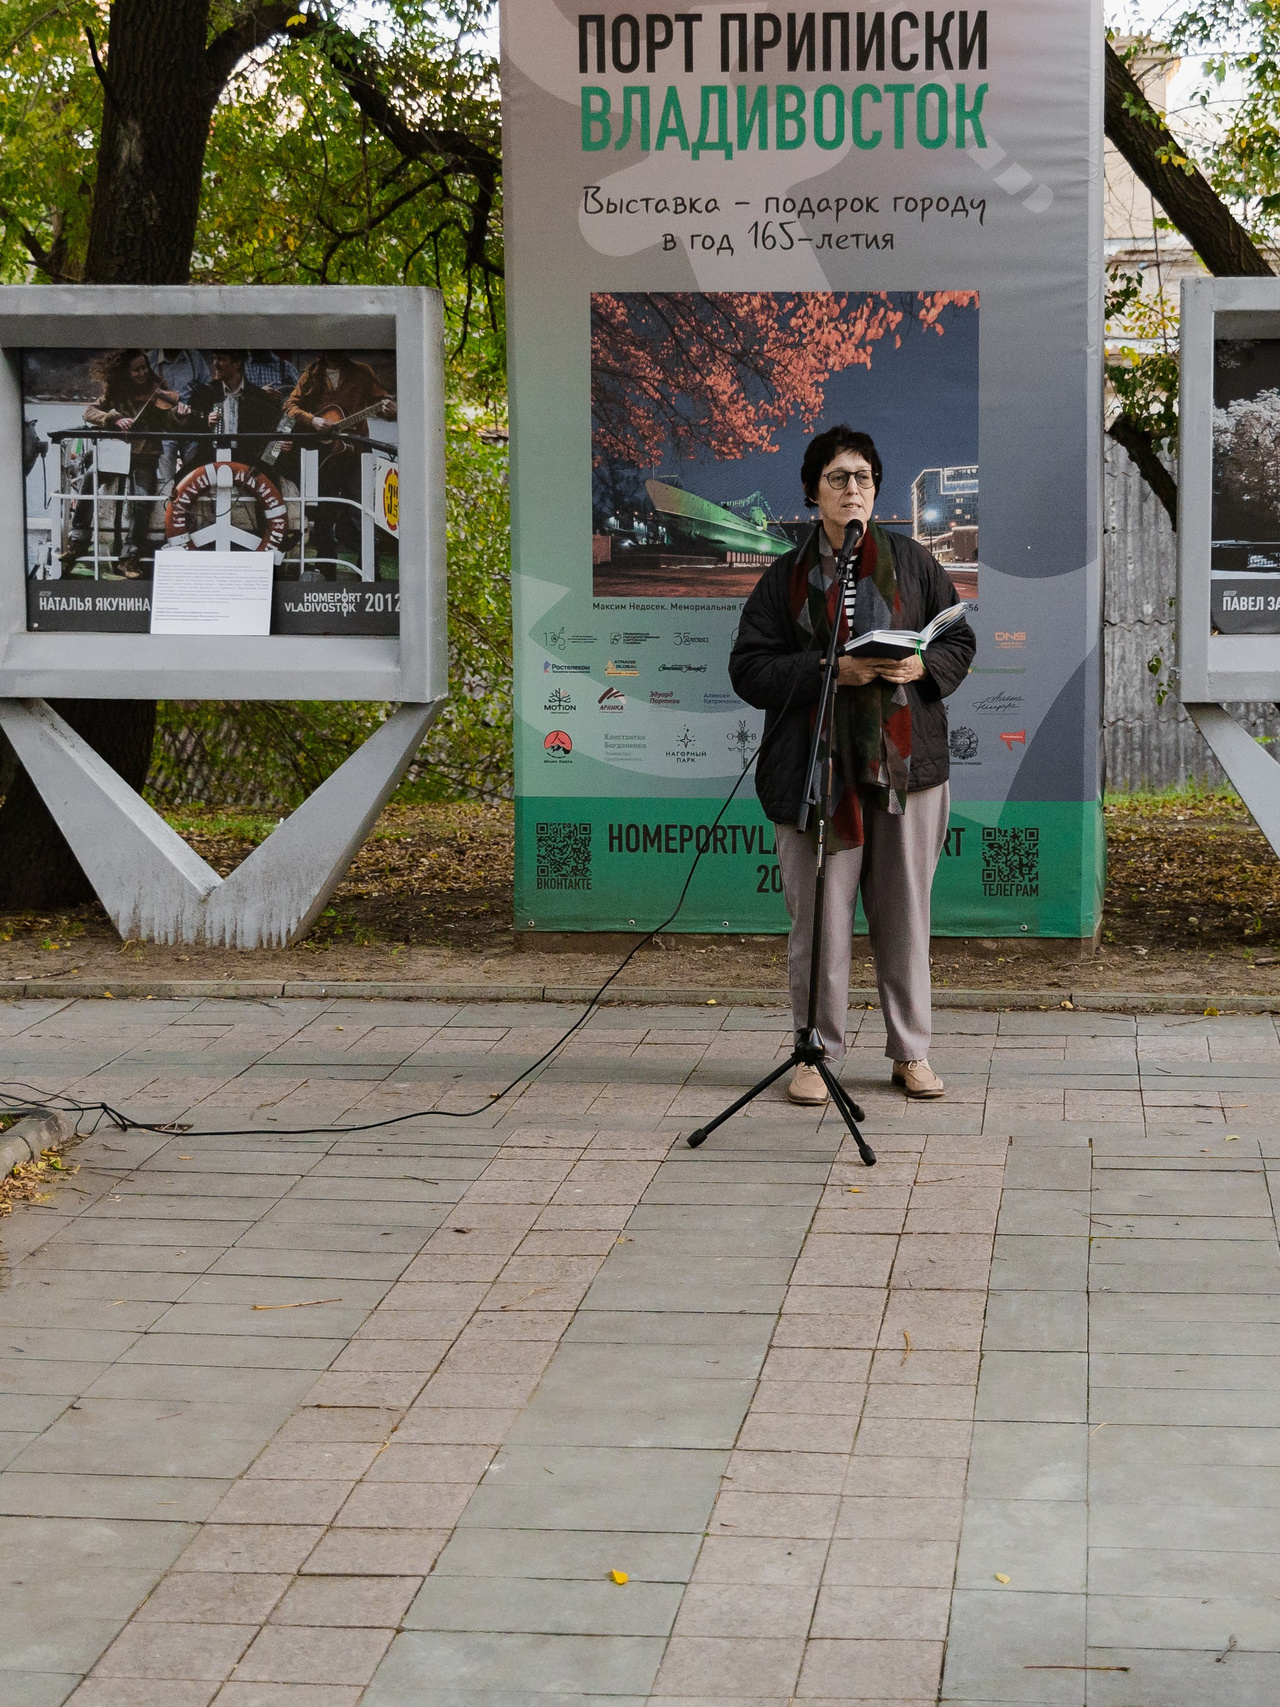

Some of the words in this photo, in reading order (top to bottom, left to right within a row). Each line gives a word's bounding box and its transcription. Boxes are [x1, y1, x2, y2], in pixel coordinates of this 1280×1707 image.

[579, 13, 702, 74] ПОРТ
[720, 10, 988, 73] ПРИПИСКИ
[581, 82, 989, 161] ВЛАДИВОСТОК
[583, 185, 721, 214] Выставка
[764, 196, 880, 223] подарок
[893, 195, 987, 226] городу
[662, 233, 678, 251] в
[690, 233, 734, 256] год
[747, 220, 895, 250] 165-летия
[39, 596, 93, 611] НАТАЛЬЯ
[95, 597, 151, 612] ЯКУНИНА
[303, 592, 362, 603] HOMEPORT
[1222, 596, 1264, 611] ПАВЕЛ
[284, 602, 357, 613] VLADIVOSTOK
[592, 602, 627, 611] Максим
[629, 602, 668, 612] Недосек.
[670, 603, 737, 612] Мемориальная
[994, 631, 1027, 641] DNS
[537, 878, 592, 890] ВКОНТАКТЕ
[982, 883, 1039, 897] ТЕЛЕГРАМ
